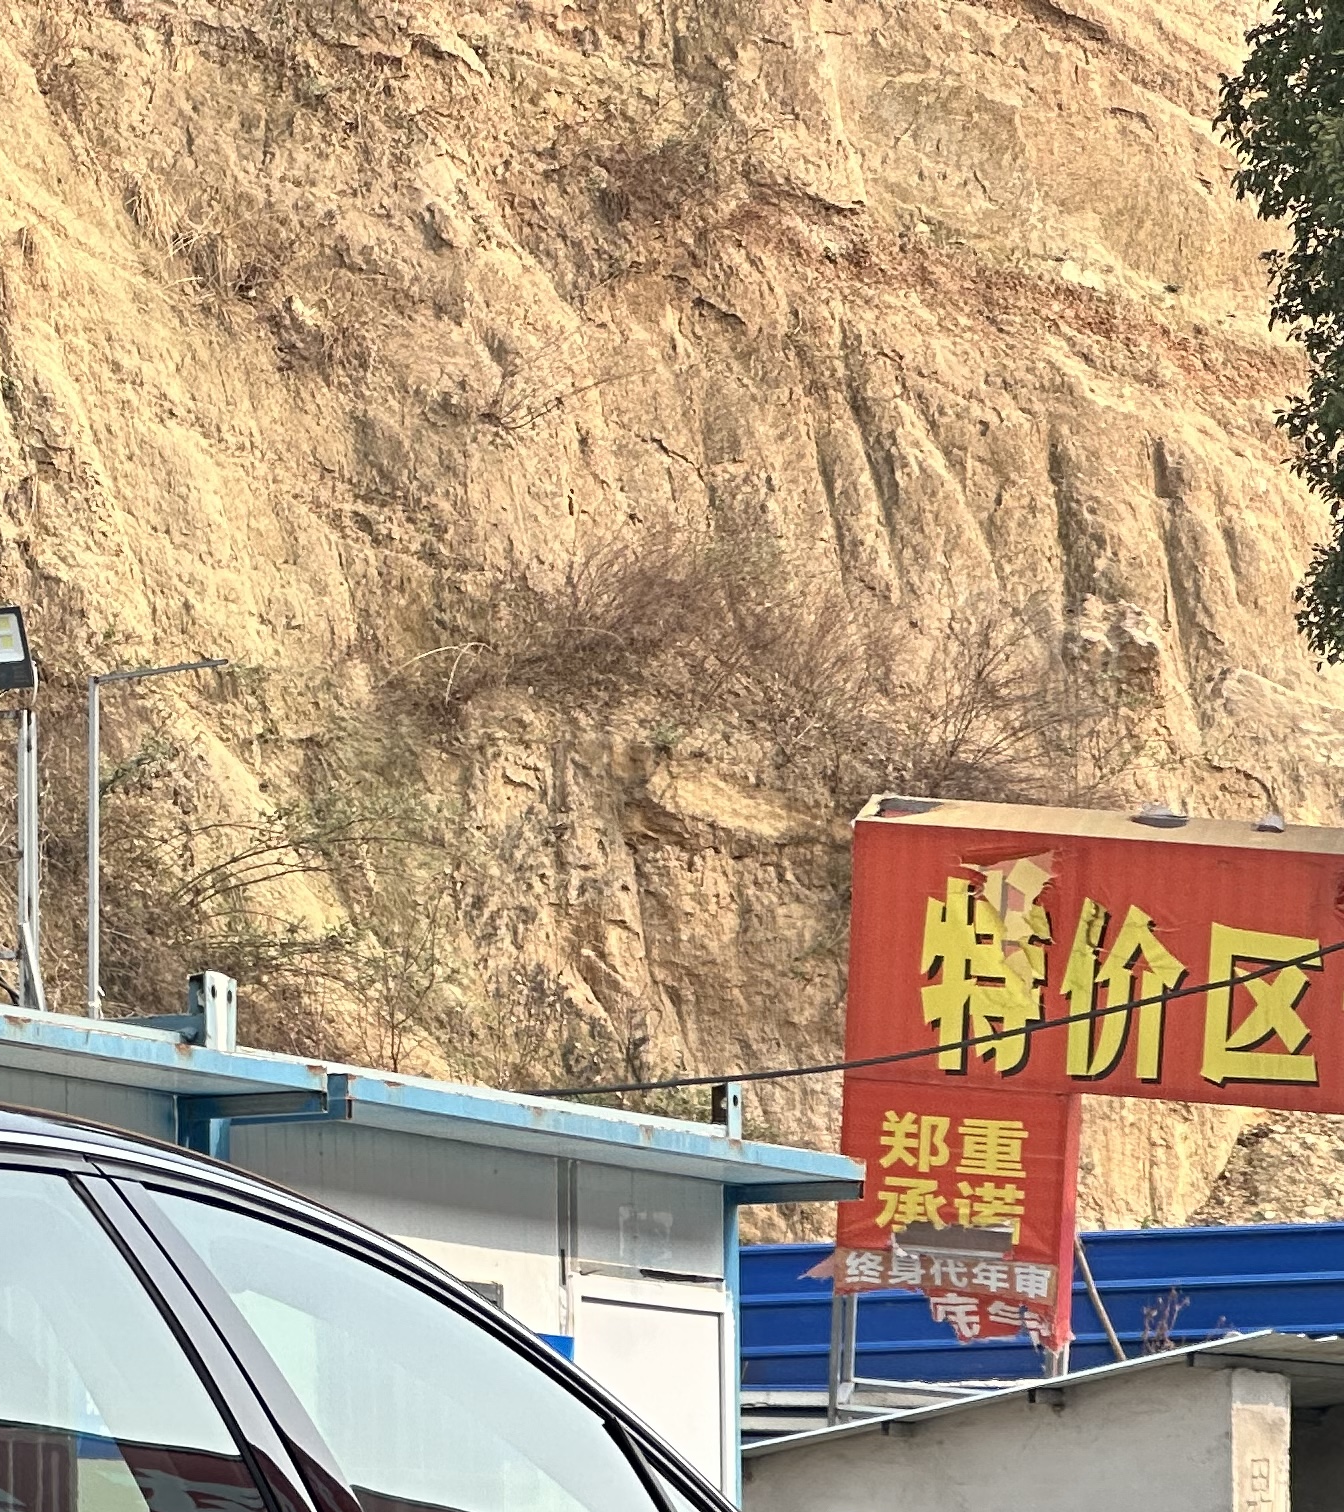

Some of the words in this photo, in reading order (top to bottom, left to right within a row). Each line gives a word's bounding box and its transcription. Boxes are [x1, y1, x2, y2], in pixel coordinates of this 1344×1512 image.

[920, 857, 1324, 1085] 特价区
[878, 1110, 1030, 1179] 郑重
[874, 1176, 1026, 1246] 承诺
[844, 1250, 1051, 1299] 终身代年审
